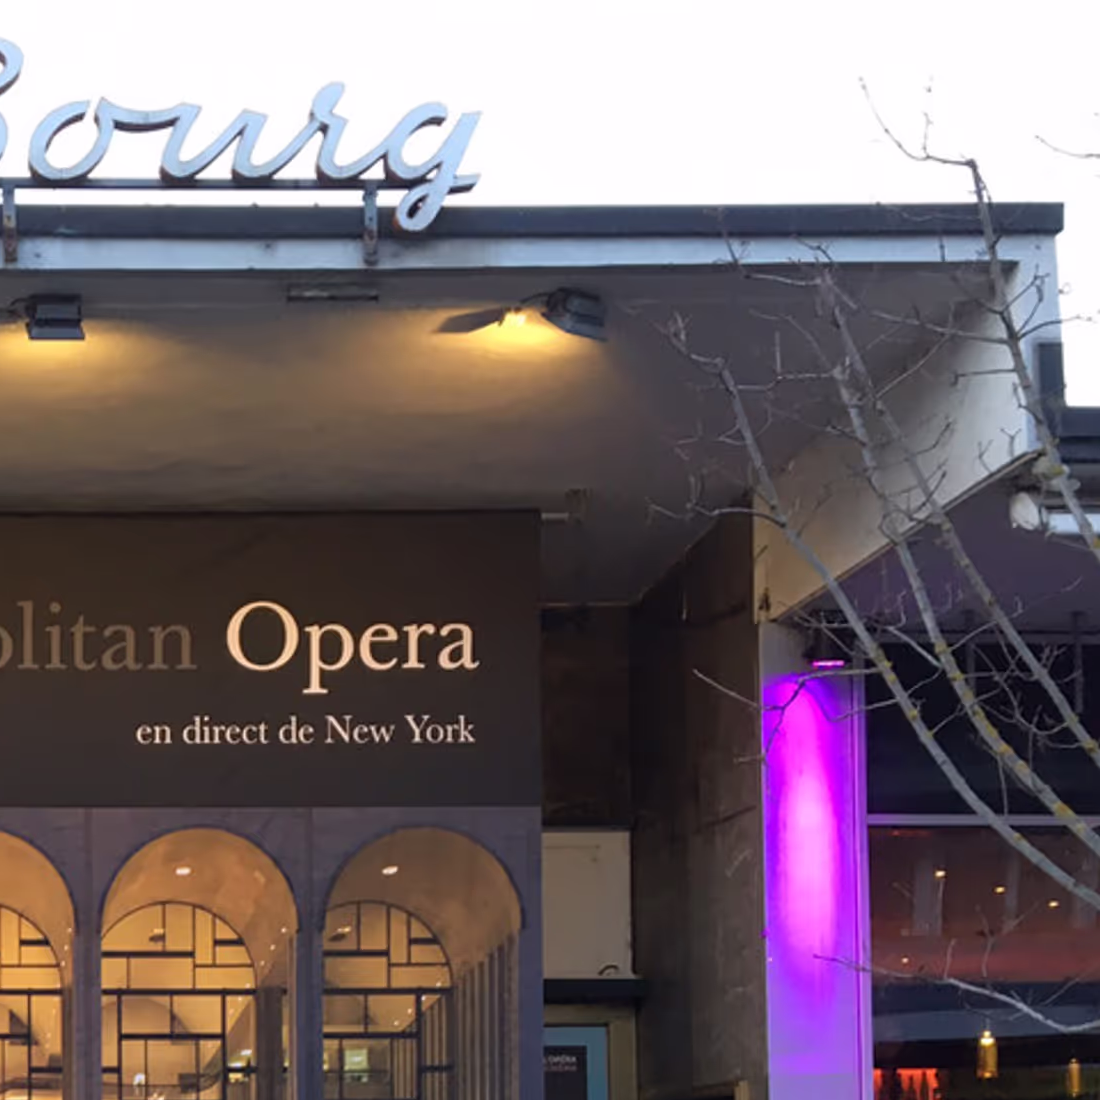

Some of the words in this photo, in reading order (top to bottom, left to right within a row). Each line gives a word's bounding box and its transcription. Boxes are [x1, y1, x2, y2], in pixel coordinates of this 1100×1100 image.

[226, 599, 480, 695] Opera
[135, 725, 173, 745] en
[181, 716, 269, 745] direct
[278, 716, 315, 745] de
[324, 716, 396, 745] New
[404, 715, 477, 745] York
